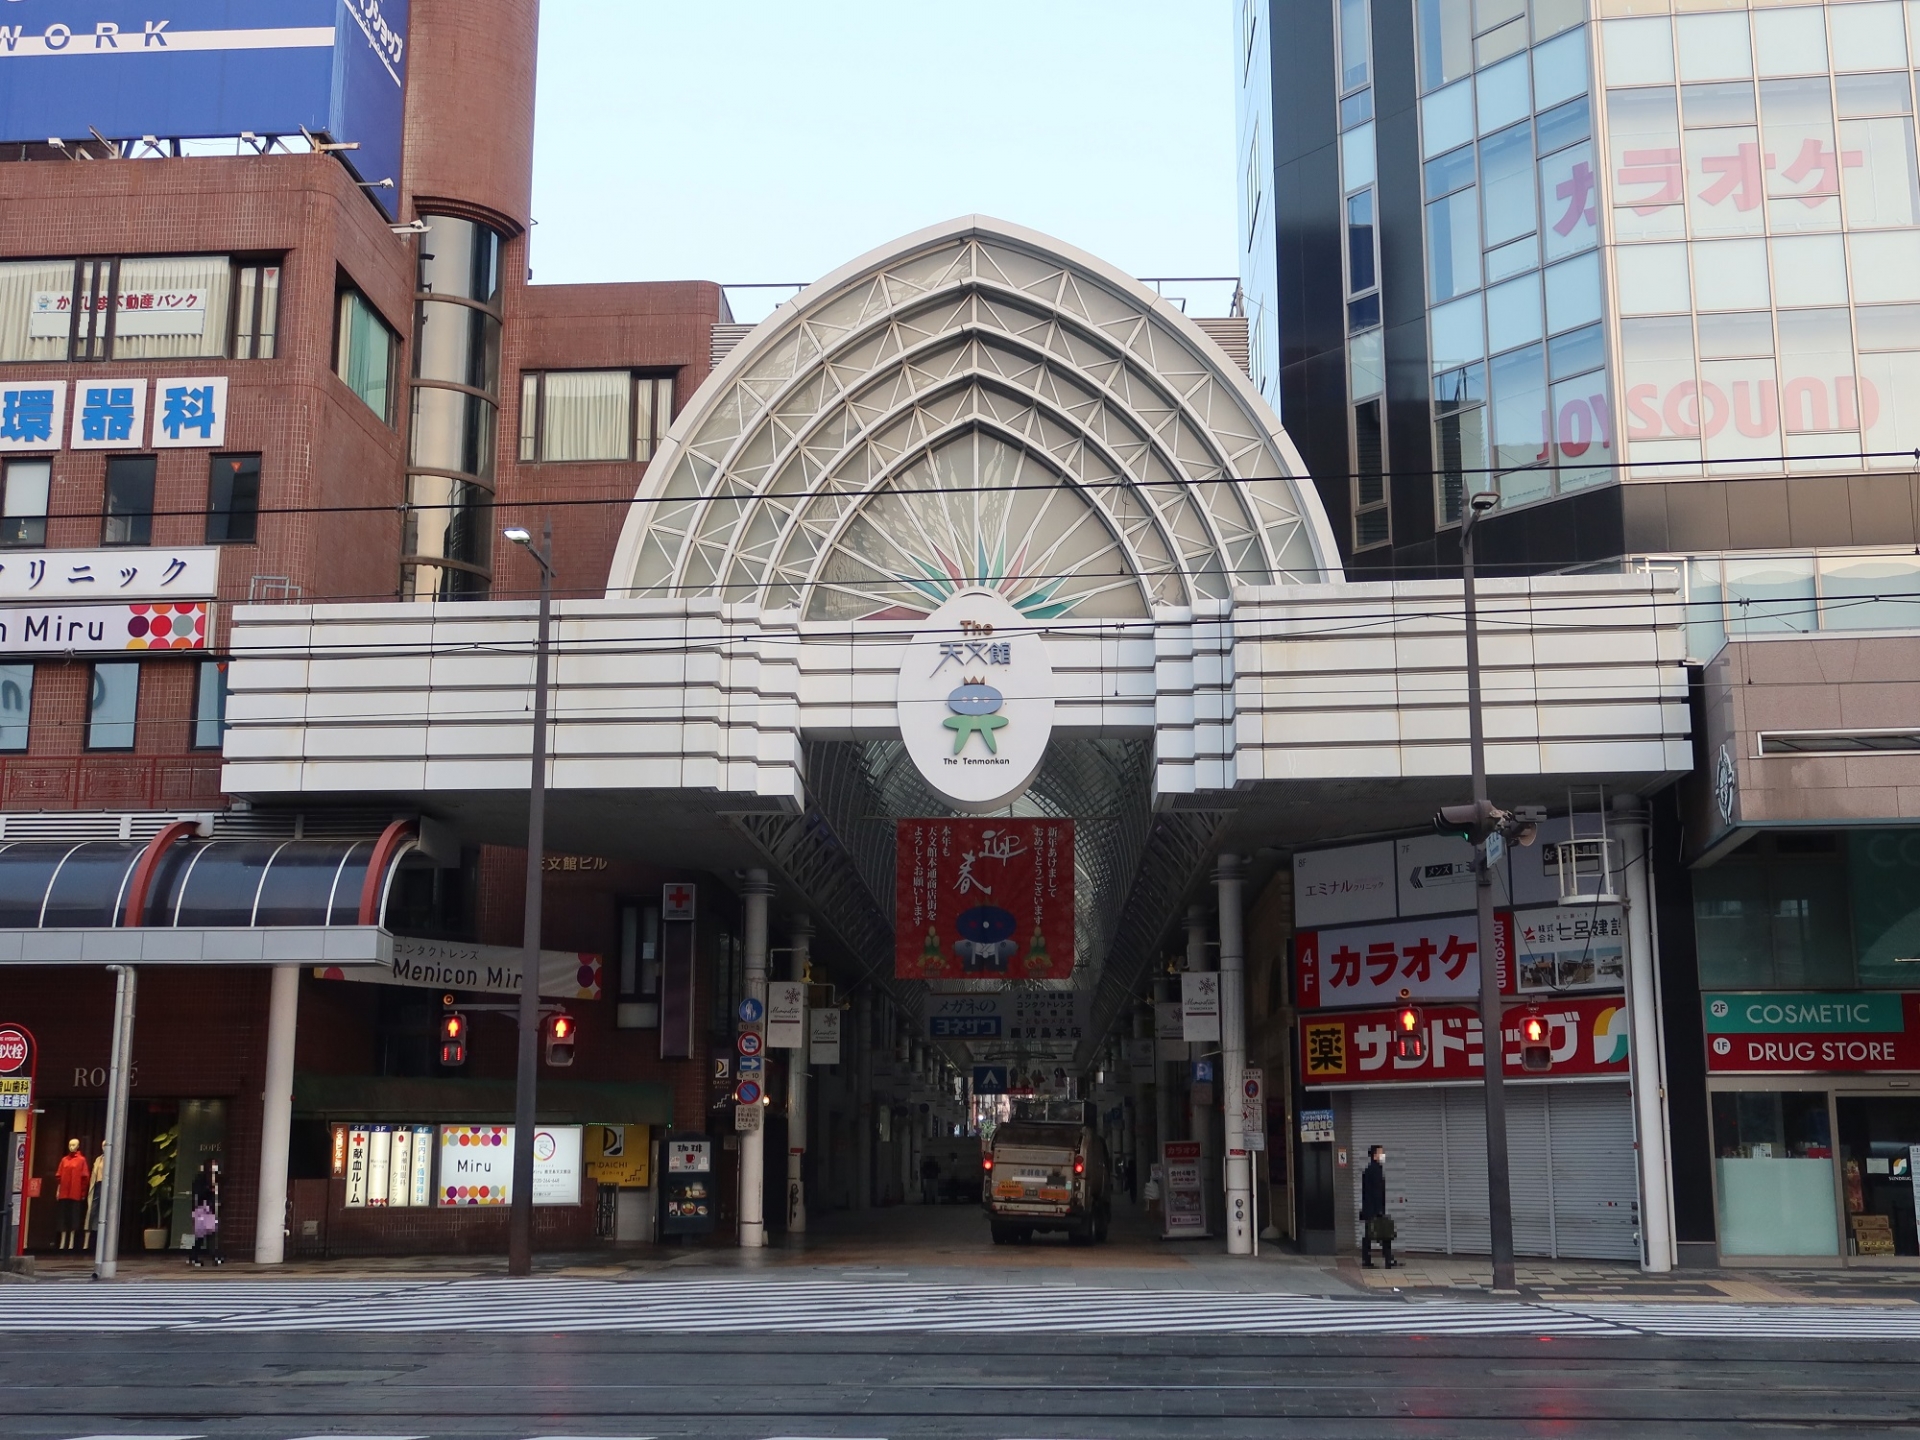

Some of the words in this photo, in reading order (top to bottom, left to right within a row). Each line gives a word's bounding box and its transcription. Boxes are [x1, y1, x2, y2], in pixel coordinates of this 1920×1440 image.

[1552, 138, 1863, 237] カラオケ
[0, 558, 188, 590] リニック
[25, 615, 104, 642] Miru
[960, 620, 994, 636] The
[929, 641, 1011, 679] 天文館
[943, 757, 958, 765] The
[963, 757, 1010, 765] Tenmonkan
[941, 826, 951, 857] 本年も
[541, 856, 608, 871] 文館ビル
[927, 826, 937, 921] 天文館本通商店街を
[1047, 826, 1058, 898] 新年あけまして
[1427, 863, 1451, 877] メンズ
[913, 826, 924, 927] よろしくお願いします
[1033, 827, 1043, 925] おめでとうございます
[394, 943, 480, 960] コンタクトレンズ
[1328, 934, 1479, 989] カラオケ
[1493, 919, 1507, 989] JOYSOUND
[393, 957, 477, 986] Menicon
[487, 967, 523, 989] Mir
[939, 998, 997, 1014] メガネの
[1712, 1003, 1726, 1014] 2F
[1746, 1003, 1870, 1024] COSMETIC
[1010, 1027, 1082, 1039] 鹿児島本店
[1715, 1041, 1729, 1052] 1F
[1309, 1027, 1343, 1071] 薬
[1748, 1042, 1815, 1062] DRUG
[1822, 1041, 1896, 1061] STORE
[72, 1060, 139, 1088] ROÉ
[350, 1148, 363, 1204] 献血ルーム
[457, 1160, 491, 1172] Miru
[598, 1161, 628, 1169] DAICHI
